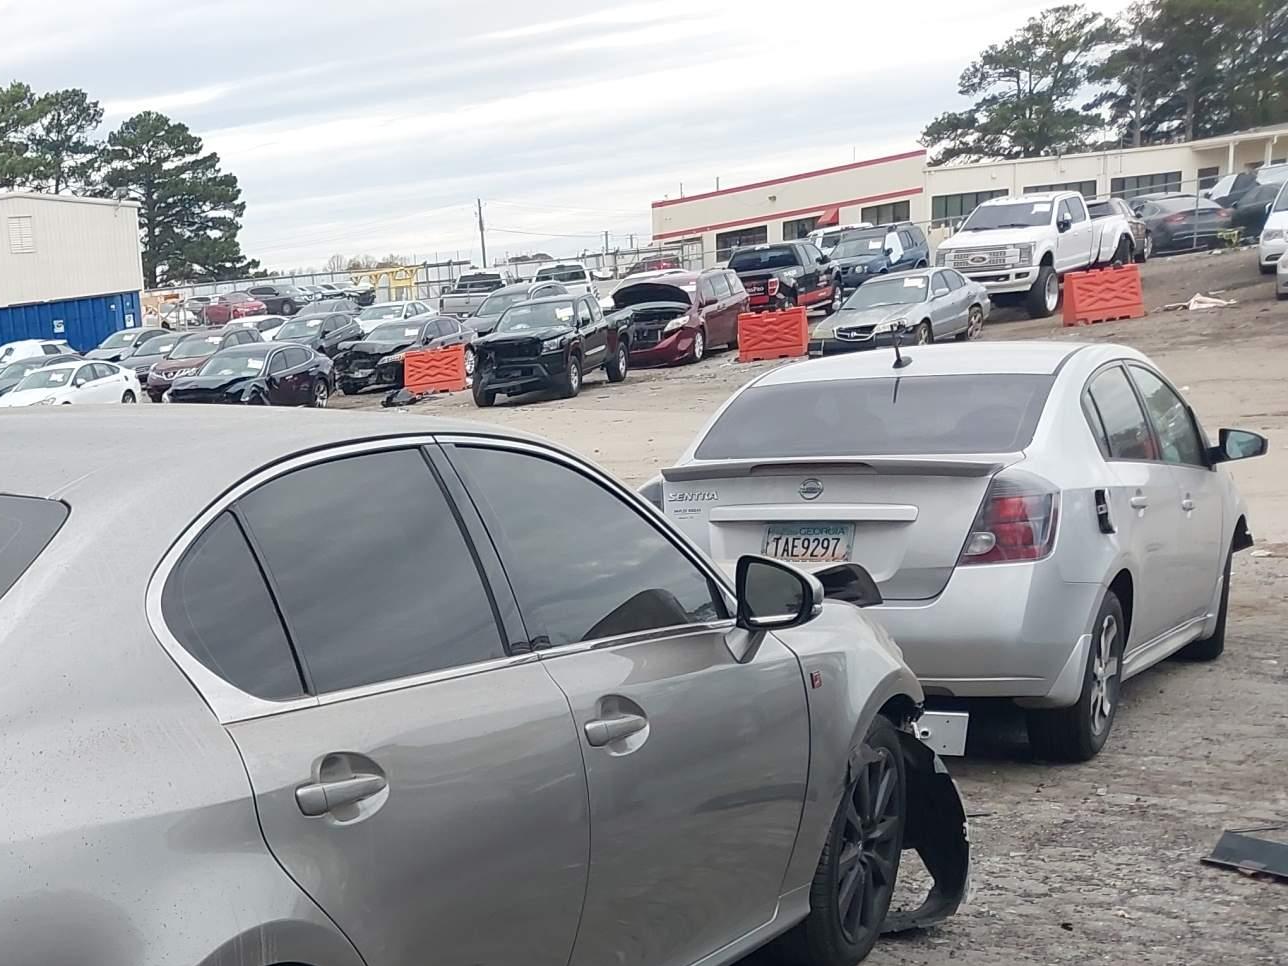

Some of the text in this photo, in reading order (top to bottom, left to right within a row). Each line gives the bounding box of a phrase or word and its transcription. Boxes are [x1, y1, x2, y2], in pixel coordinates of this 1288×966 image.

[668, 491, 720, 501] SENTRA
[799, 528, 845, 536] GEORGIA
[773, 537, 841, 558] TAE9297
